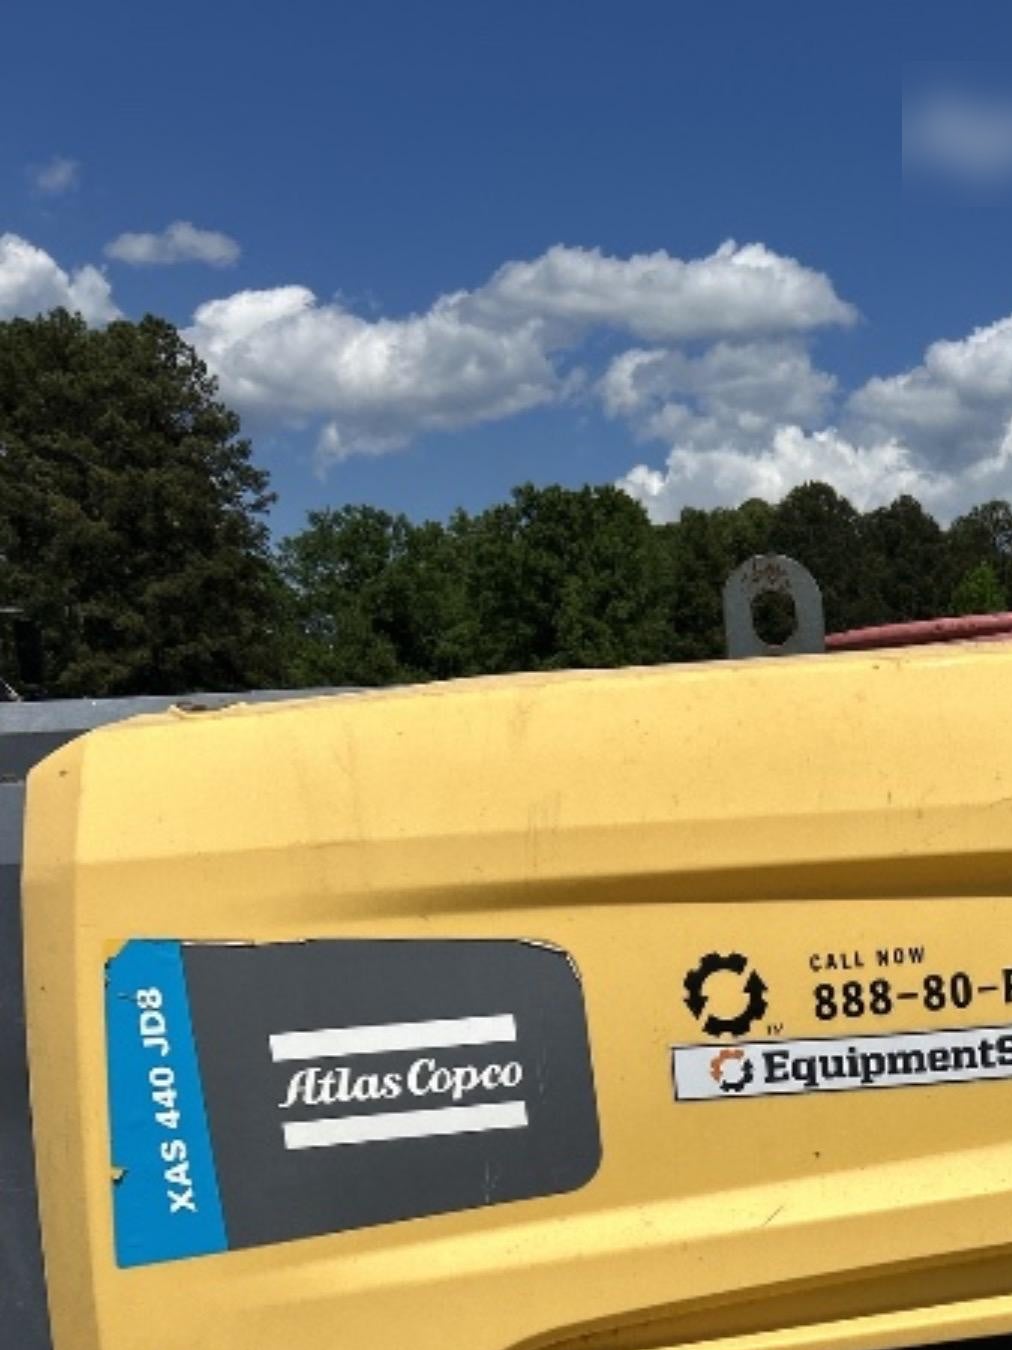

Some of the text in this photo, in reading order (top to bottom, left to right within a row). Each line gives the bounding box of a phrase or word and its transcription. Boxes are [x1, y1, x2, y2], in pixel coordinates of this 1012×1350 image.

[809, 946, 926, 972] CALL NOW
[136, 986, 197, 1213] XAS 440 JD8
[278, 1058, 524, 1108] Atlas Copco
